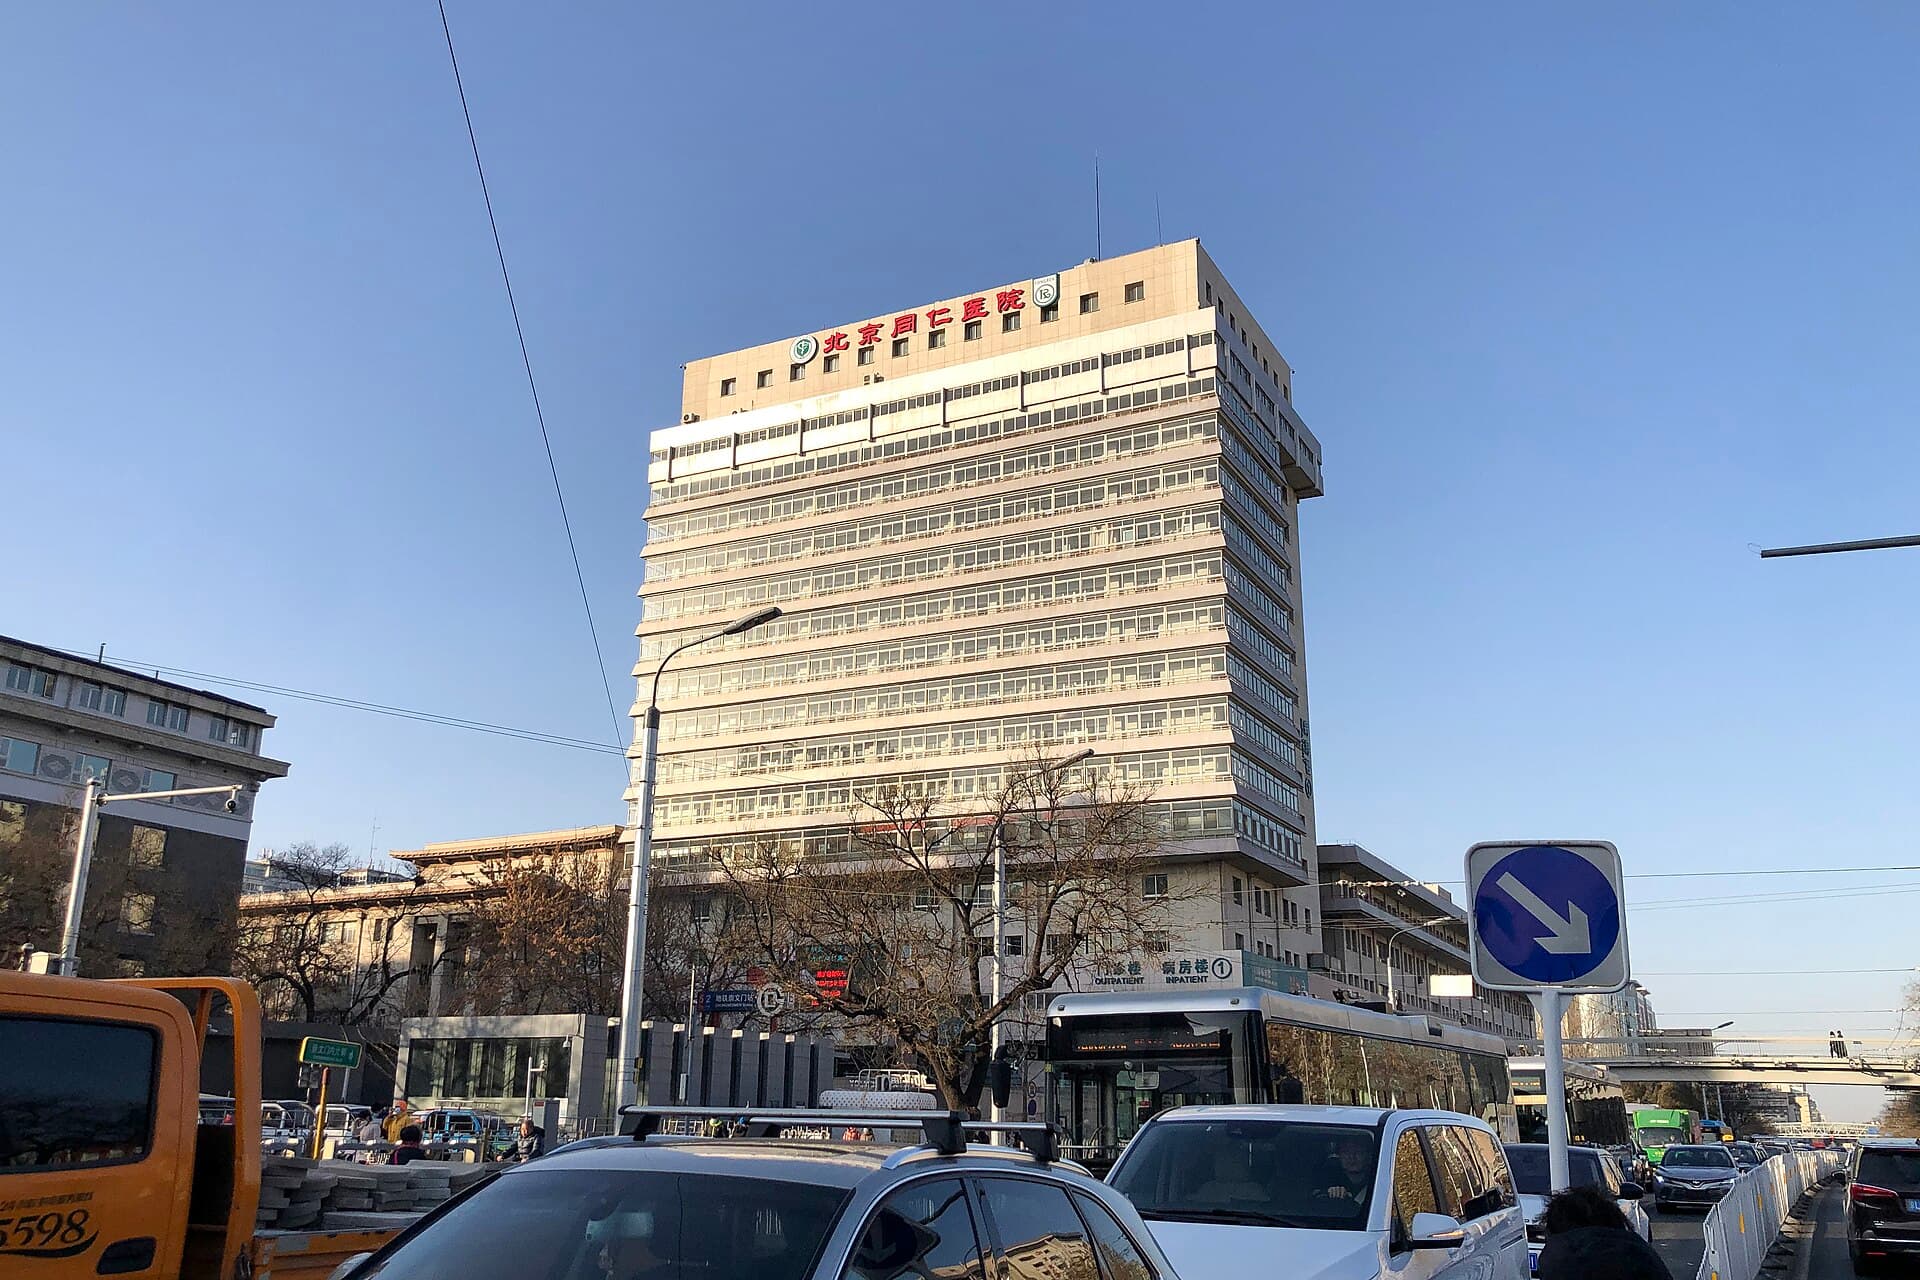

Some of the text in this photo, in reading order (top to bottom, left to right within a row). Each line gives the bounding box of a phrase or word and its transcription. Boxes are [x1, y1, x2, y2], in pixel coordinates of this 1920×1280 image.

[823, 288, 1026, 354] 北京同仁医院
[1162, 958, 1209, 975] 病房楼
[1094, 975, 1209, 985] OUTPATIENT INPATIENT
